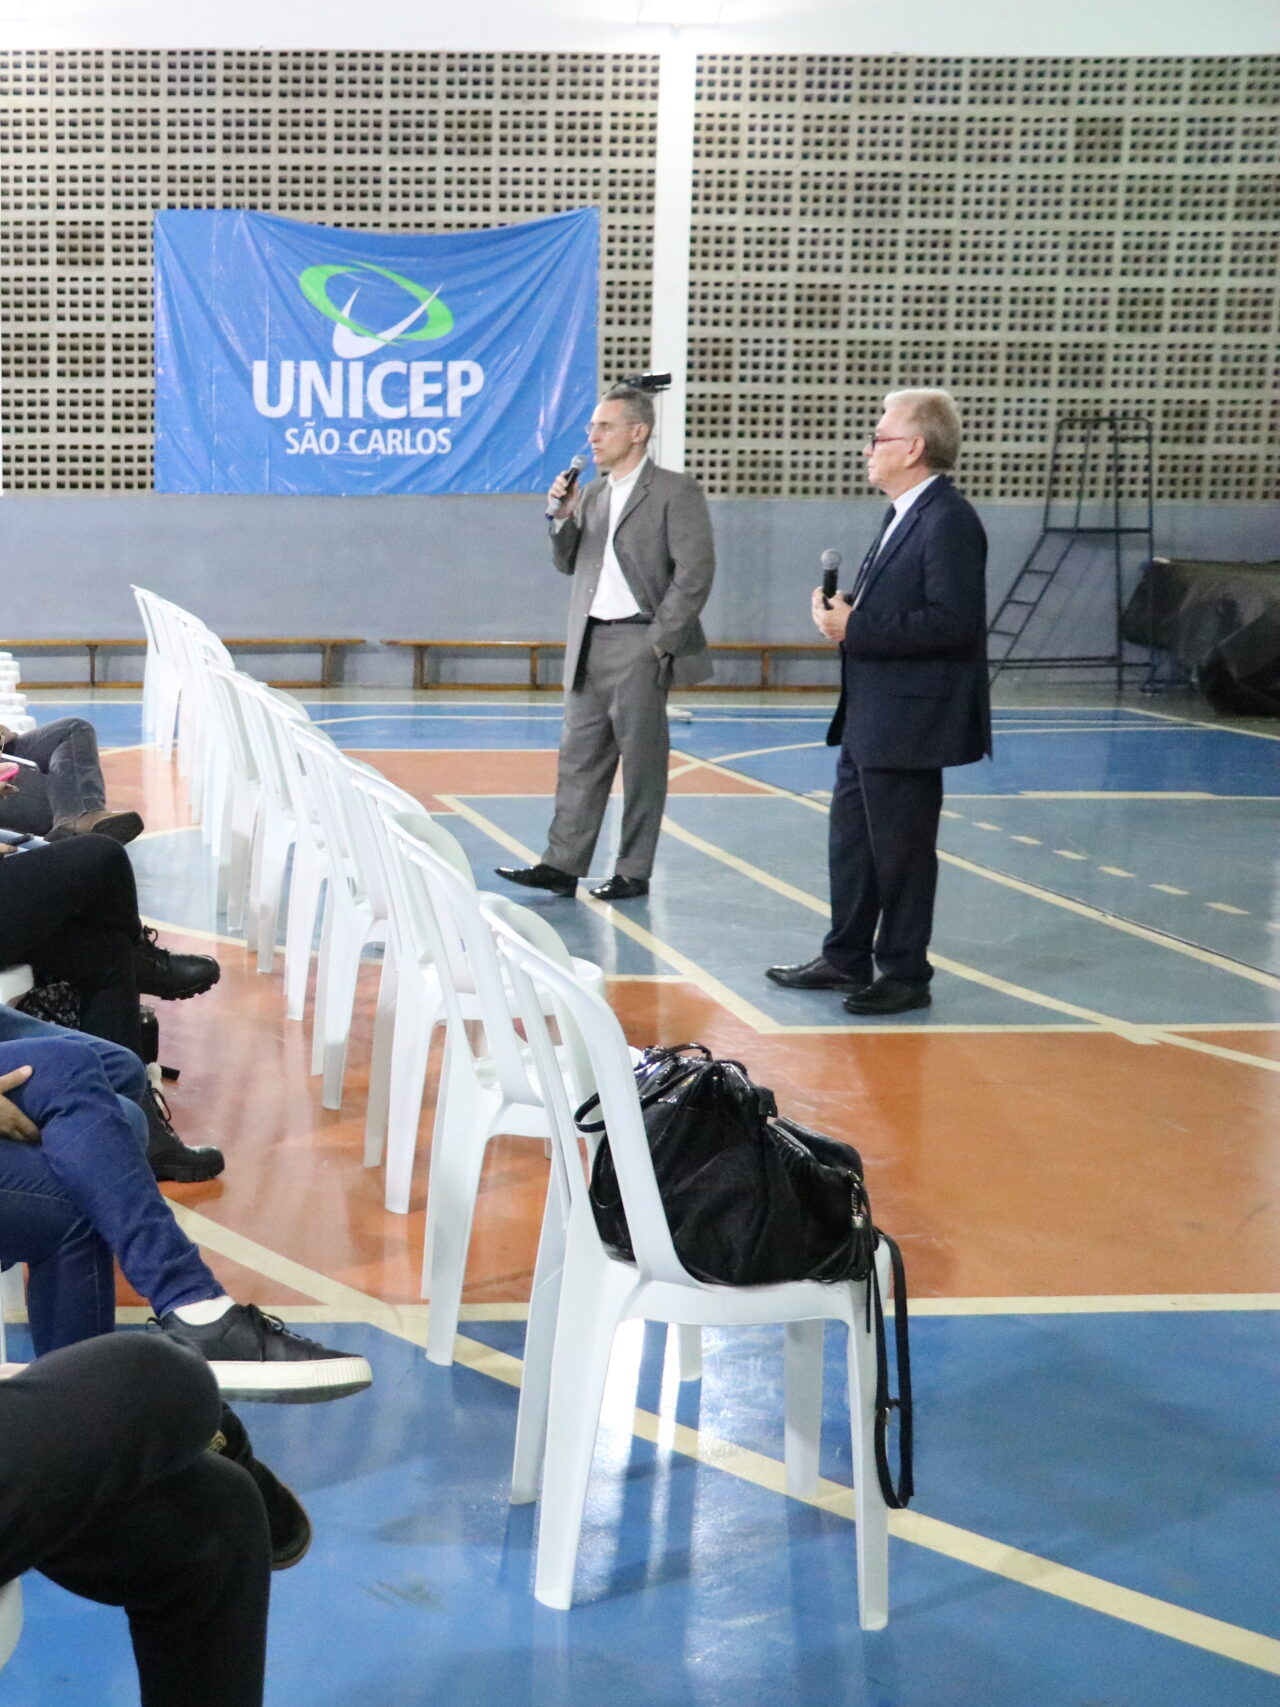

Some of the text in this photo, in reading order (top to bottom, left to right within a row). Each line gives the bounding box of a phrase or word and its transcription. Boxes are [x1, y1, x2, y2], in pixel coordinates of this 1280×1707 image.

[252, 360, 485, 419] UNICEP
[284, 421, 452, 455] SÃO CARLOS
